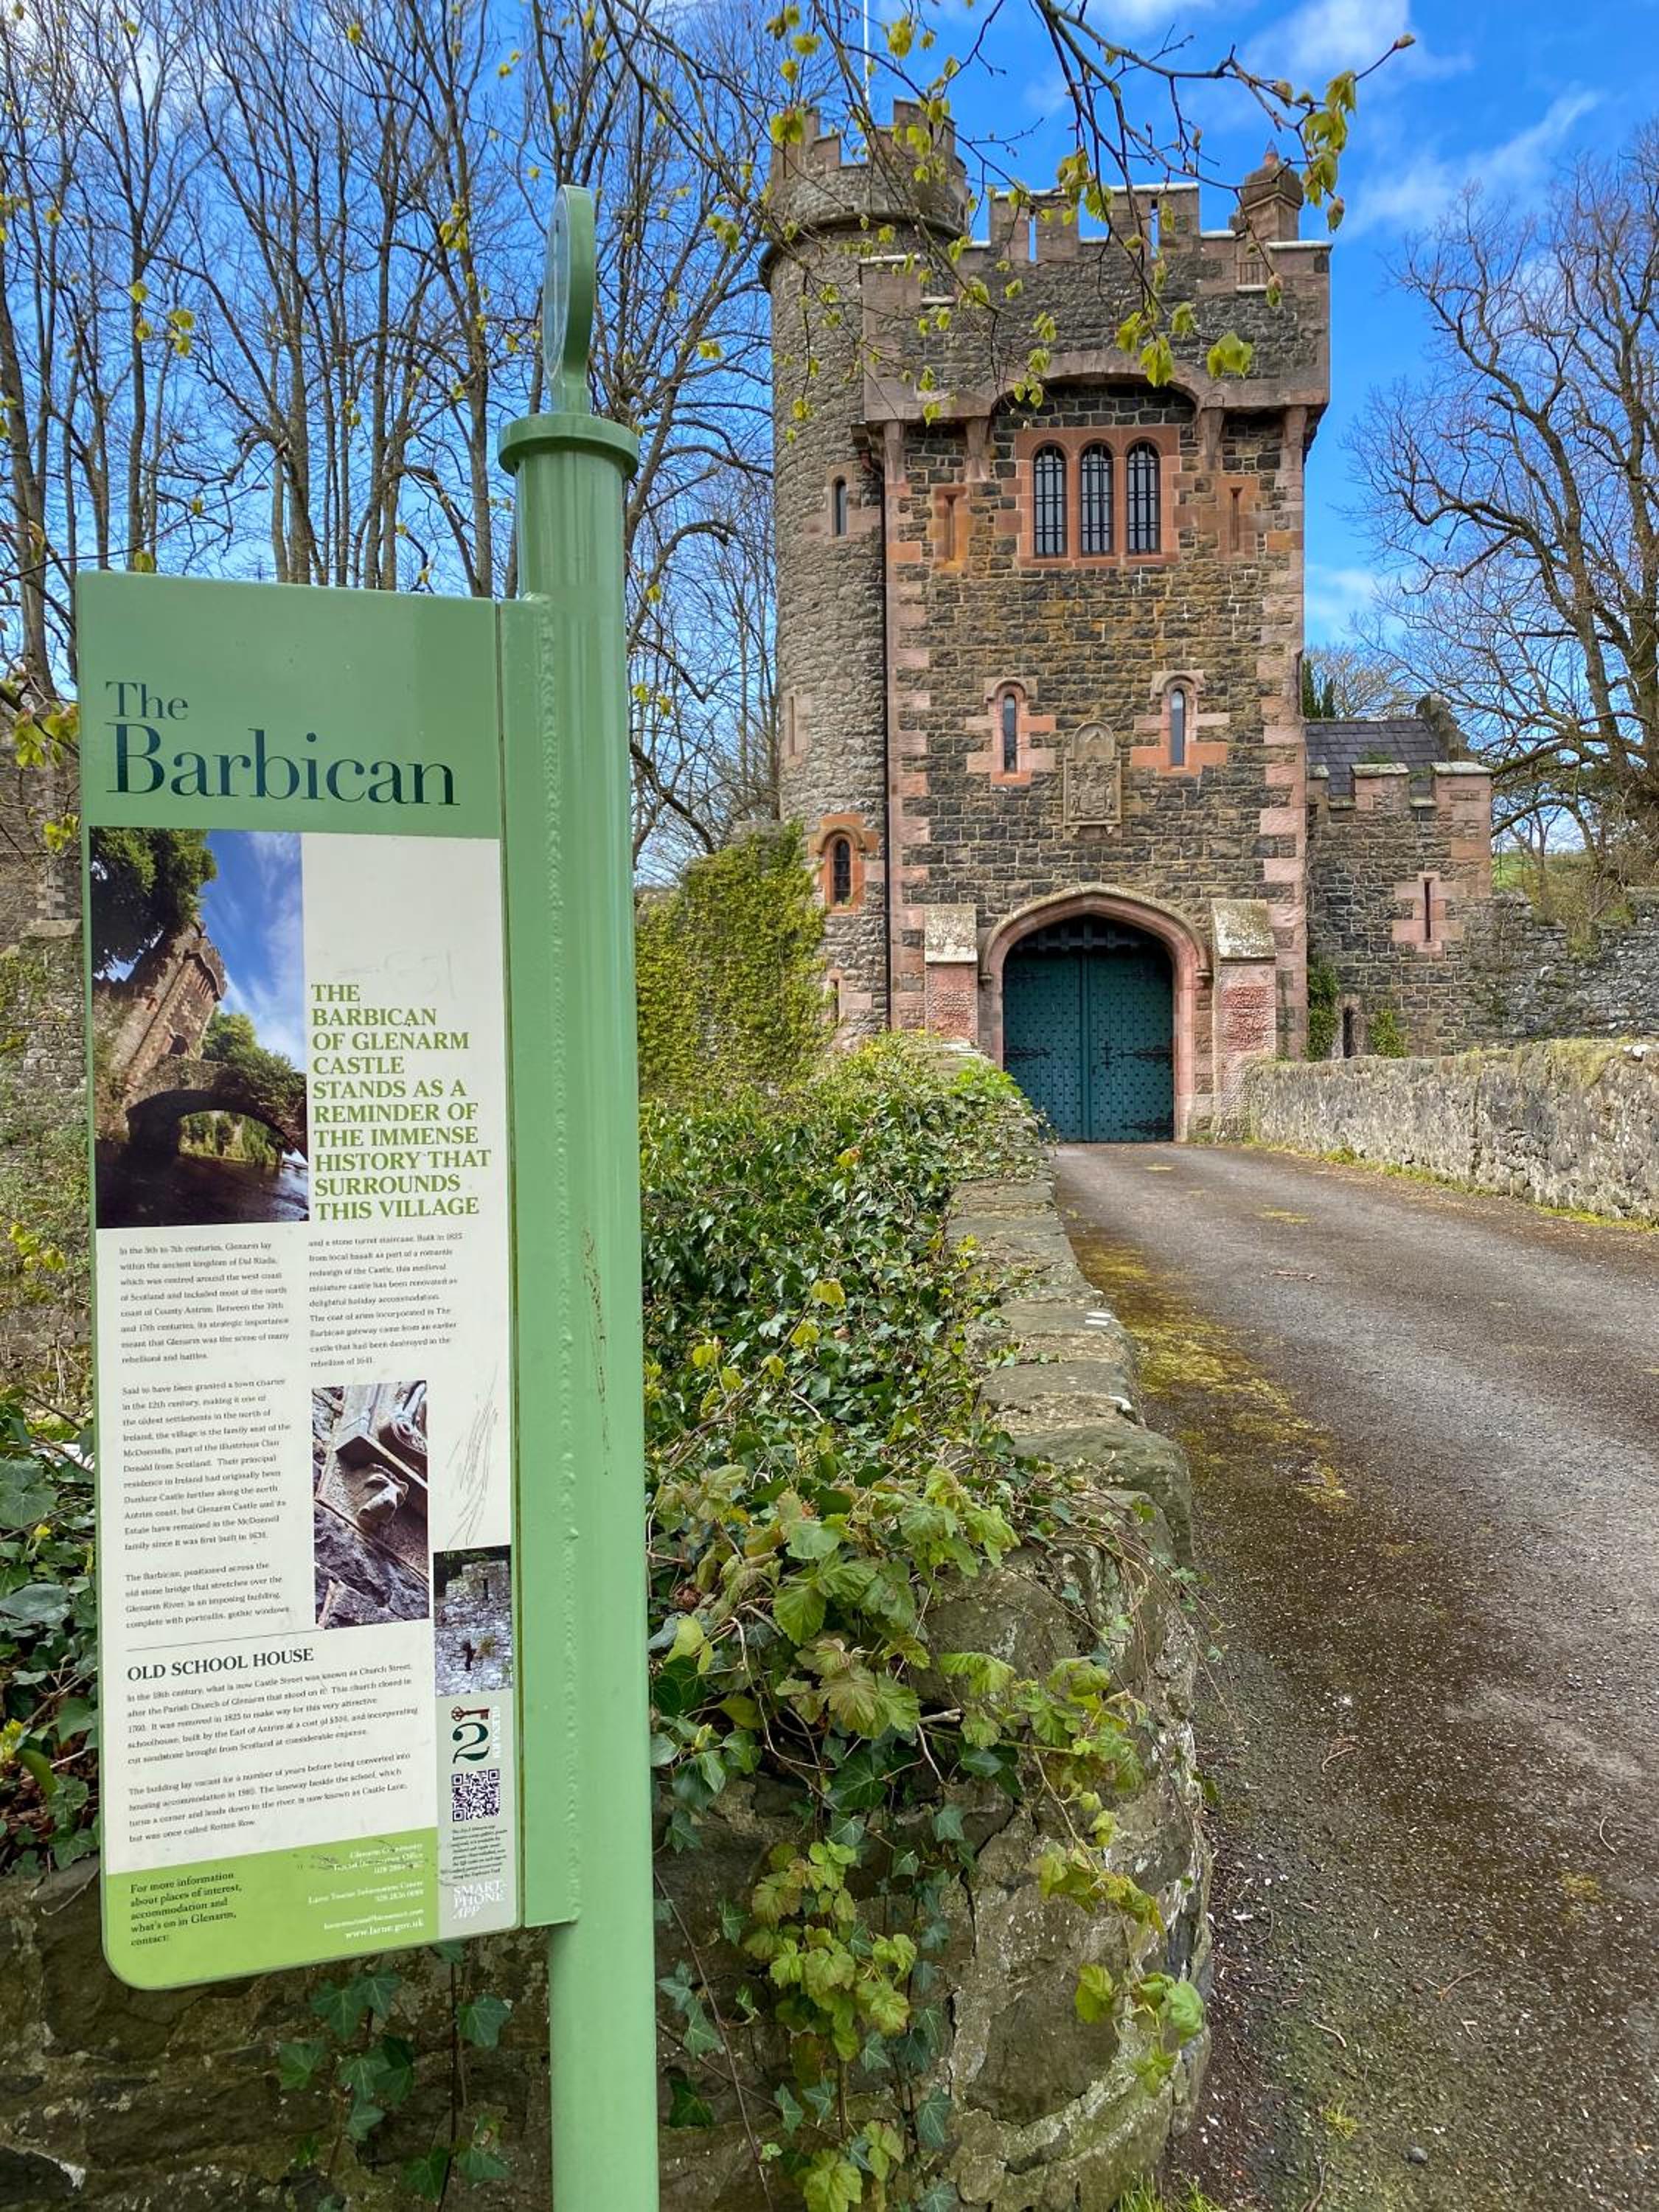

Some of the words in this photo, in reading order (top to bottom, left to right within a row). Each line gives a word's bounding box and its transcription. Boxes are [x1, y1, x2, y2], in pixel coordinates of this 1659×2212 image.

[105, 681, 189, 720] The
[105, 722, 461, 806] Barbican
[311, 984, 361, 1001] THE
[312, 1009, 437, 1026] BARBICAN
[313, 1033, 345, 1050] OF
[352, 1032, 470, 1050] GLENARM
[313, 1057, 404, 1074] CASTLE
[313, 1081, 406, 1099] STANDS
[414, 1080, 443, 1098] AS
[451, 1080, 467, 1097] A
[314, 1104, 440, 1123] REMINDER
[448, 1102, 479, 1121] OF
[314, 1130, 364, 1148] THE
[372, 1127, 479, 1146] IMMENSE
[315, 1152, 421, 1172] HISTORY
[428, 1150, 492, 1167] THAT
[315, 1175, 461, 1197] SURROUNDS
[316, 1203, 372, 1220] THIS
[379, 1198, 479, 1217] VILLAGE
[128, 1664, 166, 1681] OLD
[171, 1656, 248, 1676] SCHOOL
[253, 1648, 314, 1667] HOUSE
[453, 1722, 490, 1763] 2
[131, 1884, 147, 1893] For
[150, 1882, 175, 1891] more
[176, 1872, 234, 1887] information
[131, 1896, 159, 1907] about
[160, 1893, 189, 1905] places
[192, 1889, 203, 1897] of
[131, 1902, 208, 1920] accommodation
[209, 1898, 228, 1908] and
[131, 1921, 161, 1933] what's
[178, 1917, 188, 1926] in
